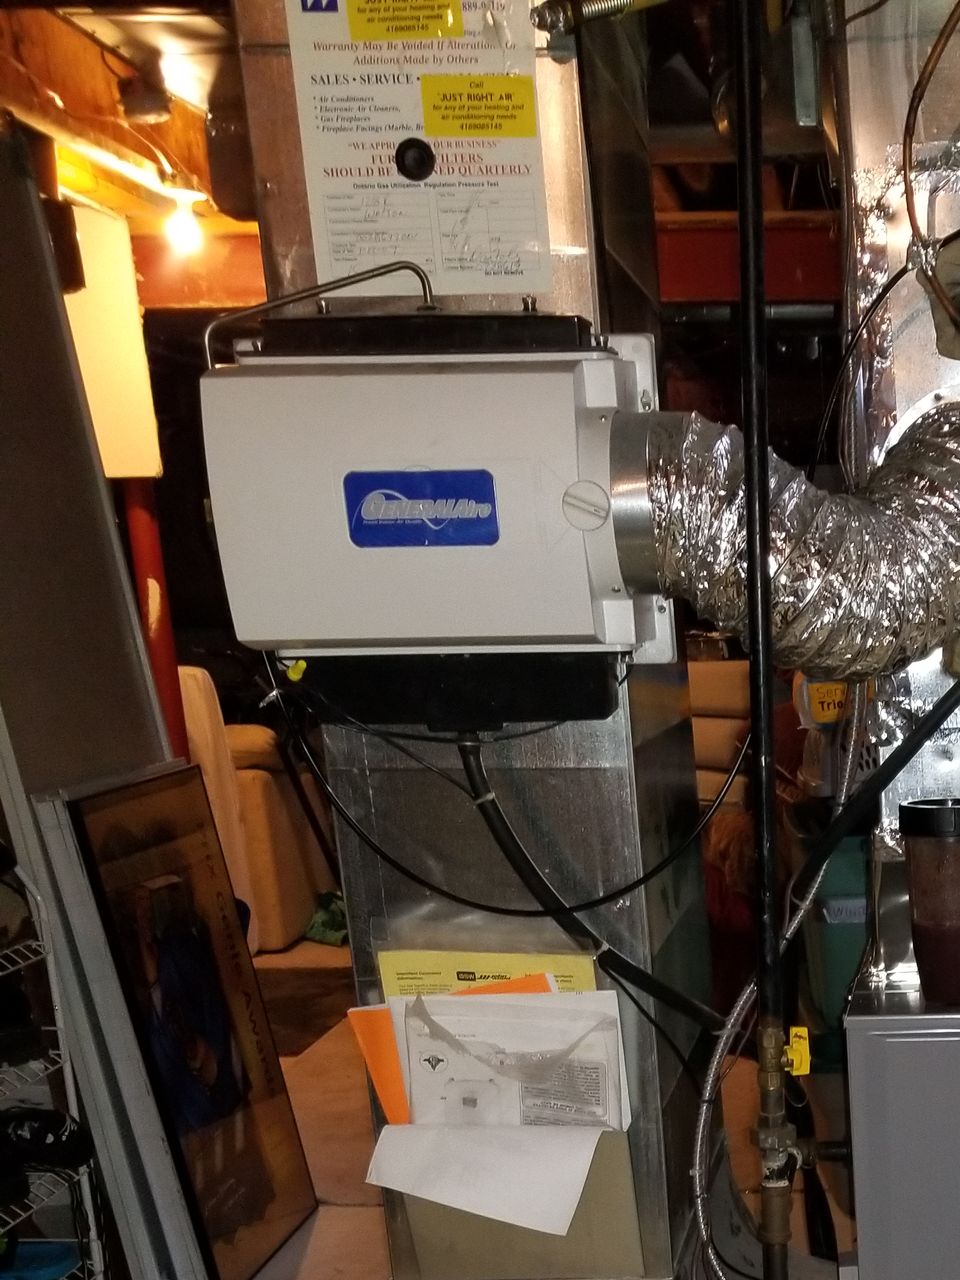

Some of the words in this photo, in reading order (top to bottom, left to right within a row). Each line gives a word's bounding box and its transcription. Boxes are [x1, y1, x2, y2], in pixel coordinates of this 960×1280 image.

[313, 41, 359, 51] Warranty
[363, 41, 384, 51] May
[386, 41, 398, 50] Be
[401, 41, 434, 50] Voided
[353, 55, 400, 66] Additions
[403, 55, 429, 65] Made
[432, 55, 444, 66] by
[446, 55, 479, 65] Others
[310, 73, 350, 86] SALES
[359, 73, 414, 85] SERVICE
[331, 95, 374, 103] Conditioners
[336, 115, 371, 123] Fireplaces
[323, 167, 374, 178] SHOULD
[377, 167, 391, 177] BE
[458, 165, 532, 177] QUARTERLY
